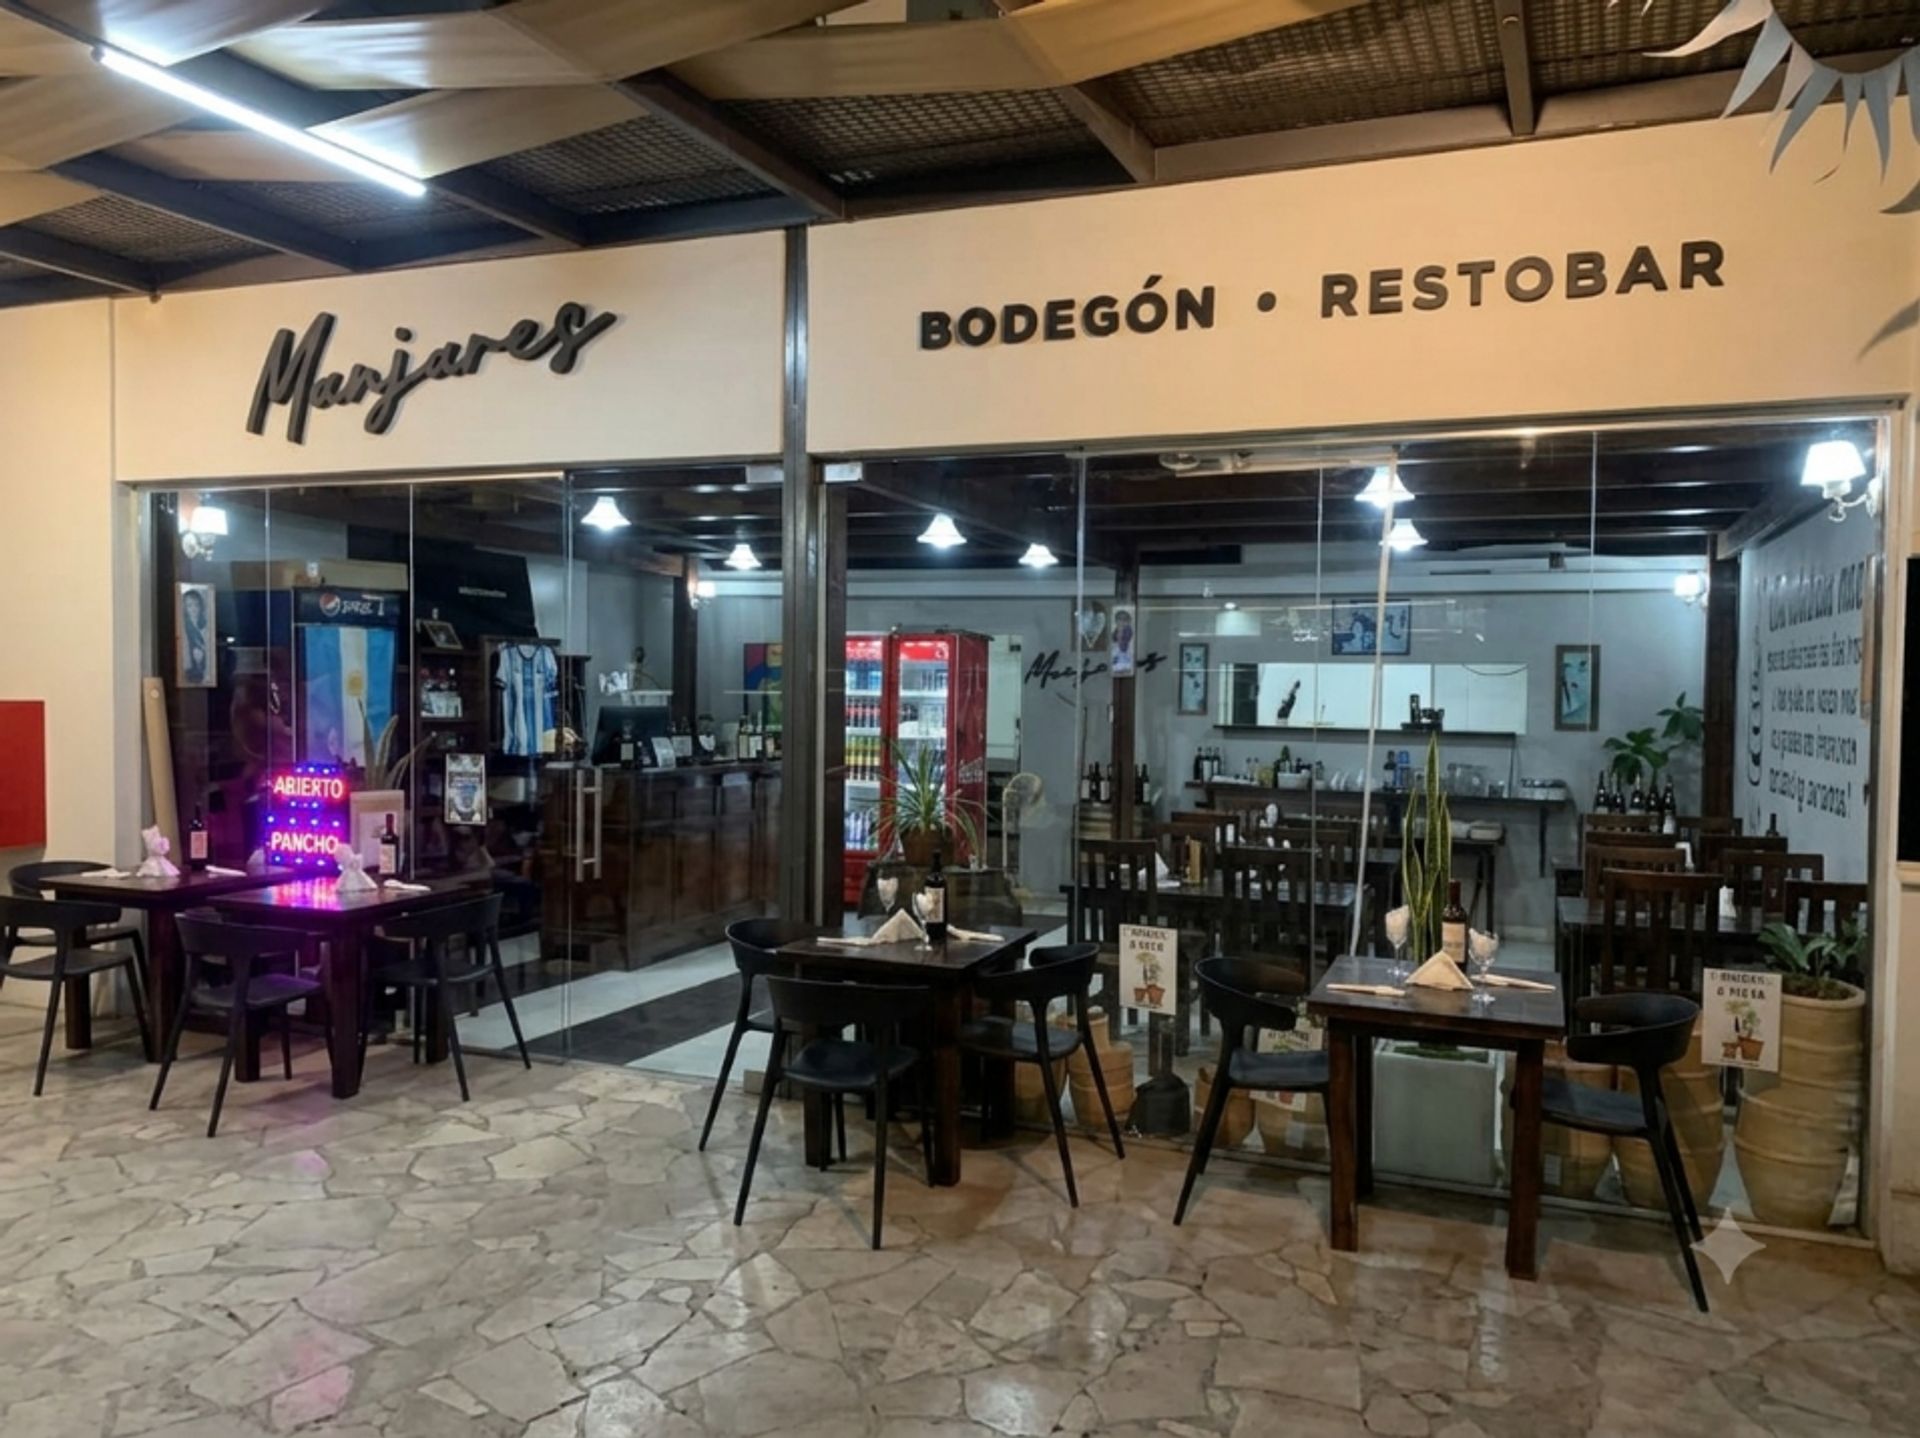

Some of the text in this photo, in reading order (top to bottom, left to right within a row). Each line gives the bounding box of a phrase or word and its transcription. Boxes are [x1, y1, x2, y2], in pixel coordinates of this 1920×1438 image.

[919, 240, 1726, 351] BODEGÓN RESTOBAR
[247, 301, 618, 445] Manjares
[273, 776, 343, 798] ABIERTO
[271, 831, 340, 855] PANCHO
